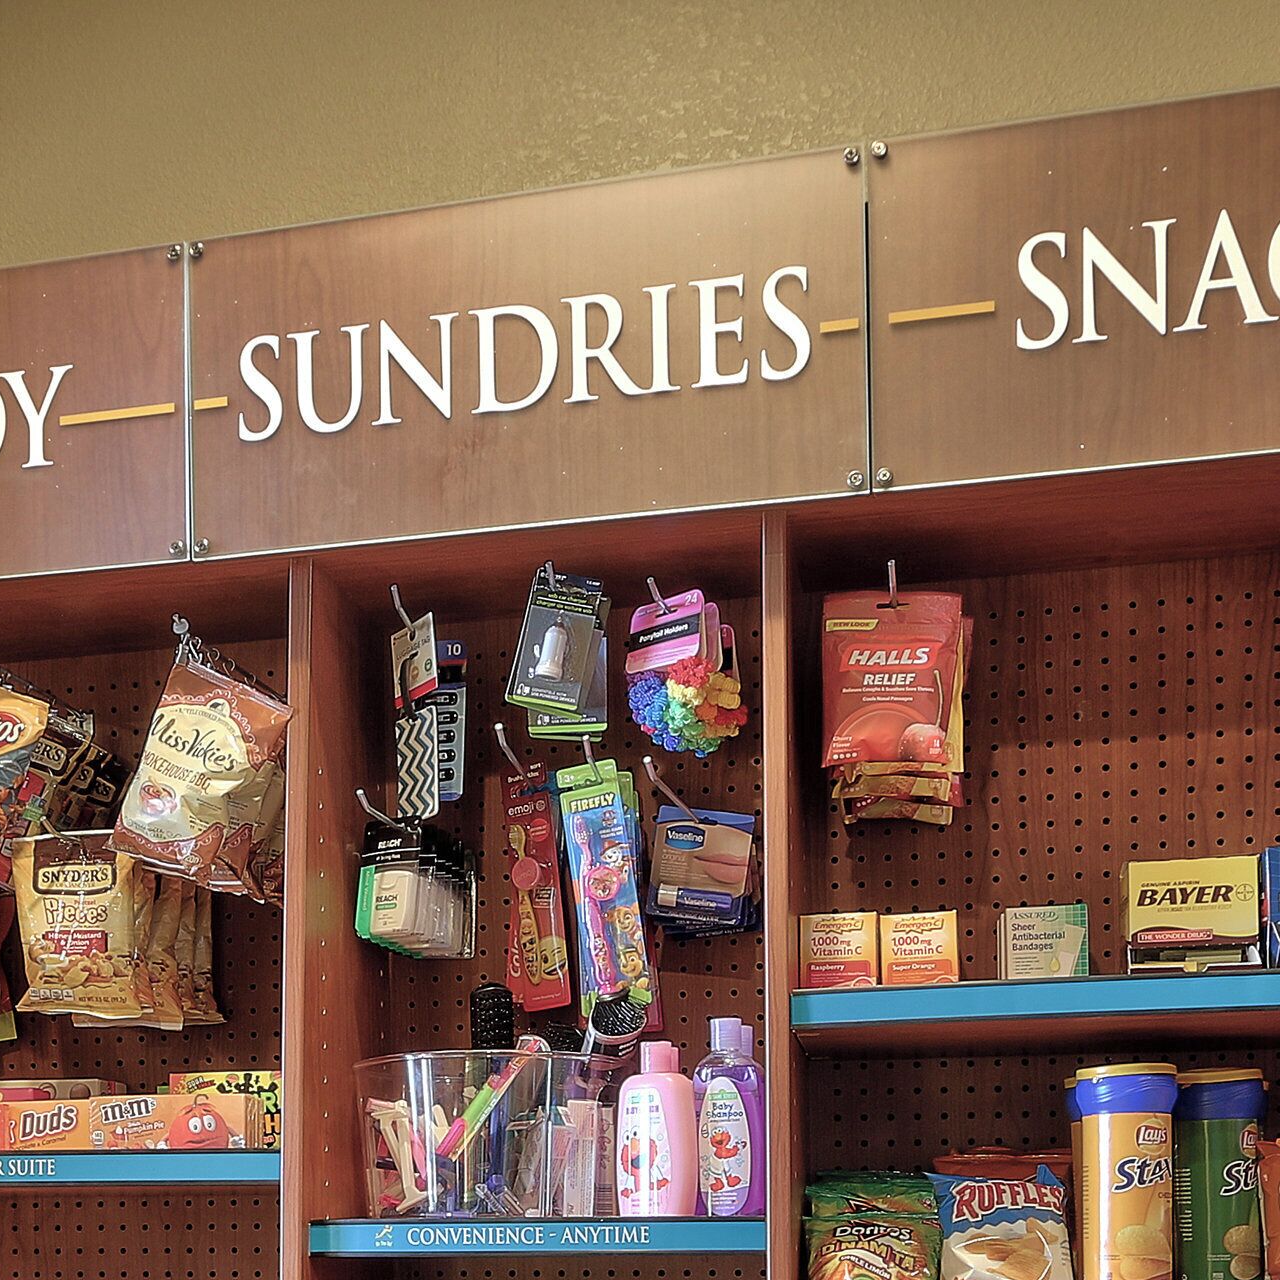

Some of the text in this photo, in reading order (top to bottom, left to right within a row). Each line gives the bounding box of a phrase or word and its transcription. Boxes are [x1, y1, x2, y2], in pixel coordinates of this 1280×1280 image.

[238, 265, 813, 443] SUNDRIES
[685, 594, 698, 606] 24
[447, 643, 461, 655] 10
[849, 647, 930, 665] HALLS
[863, 673, 916, 685] RELIEF
[151, 713, 240, 773] Miss Vickie's
[507, 802, 535, 817] emoji
[570, 793, 615, 813] FIREFLY
[667, 829, 704, 843] Vaseline
[378, 838, 402, 849] REACH
[42, 868, 109, 883] SNYDER'S
[376, 894, 399, 902] REACH
[1137, 883, 1235, 907] BAYER
[683, 896, 717, 908] Vaseline
[43, 898, 107, 924] Pieces
[1009, 910, 1059, 923] ASSURED
[1011, 922, 1036, 932] Sheer
[1011, 930, 1066, 941] Antibacterial
[811, 945, 862, 956] Vitamin C
[892, 945, 943, 956] Vitamin C
[1011, 941, 1054, 952] Bandages
[810, 963, 845, 972] Raspberry
[912, 962, 936, 971] Orange
[712, 1102, 734, 1111] Baby
[705, 1110, 744, 1118] Shampoo
[20, 1105, 78, 1141] Duds
[123, 1120, 166, 1135] Pumpkin Pie
[8, 1158, 56, 1177] SUITE
[952, 1180, 1065, 1222] RUFFLES
[407, 1226, 544, 1245] CONVENIENCE
[560, 1226, 650, 1244] ANYTIME
[835, 1225, 914, 1241] Doritos
